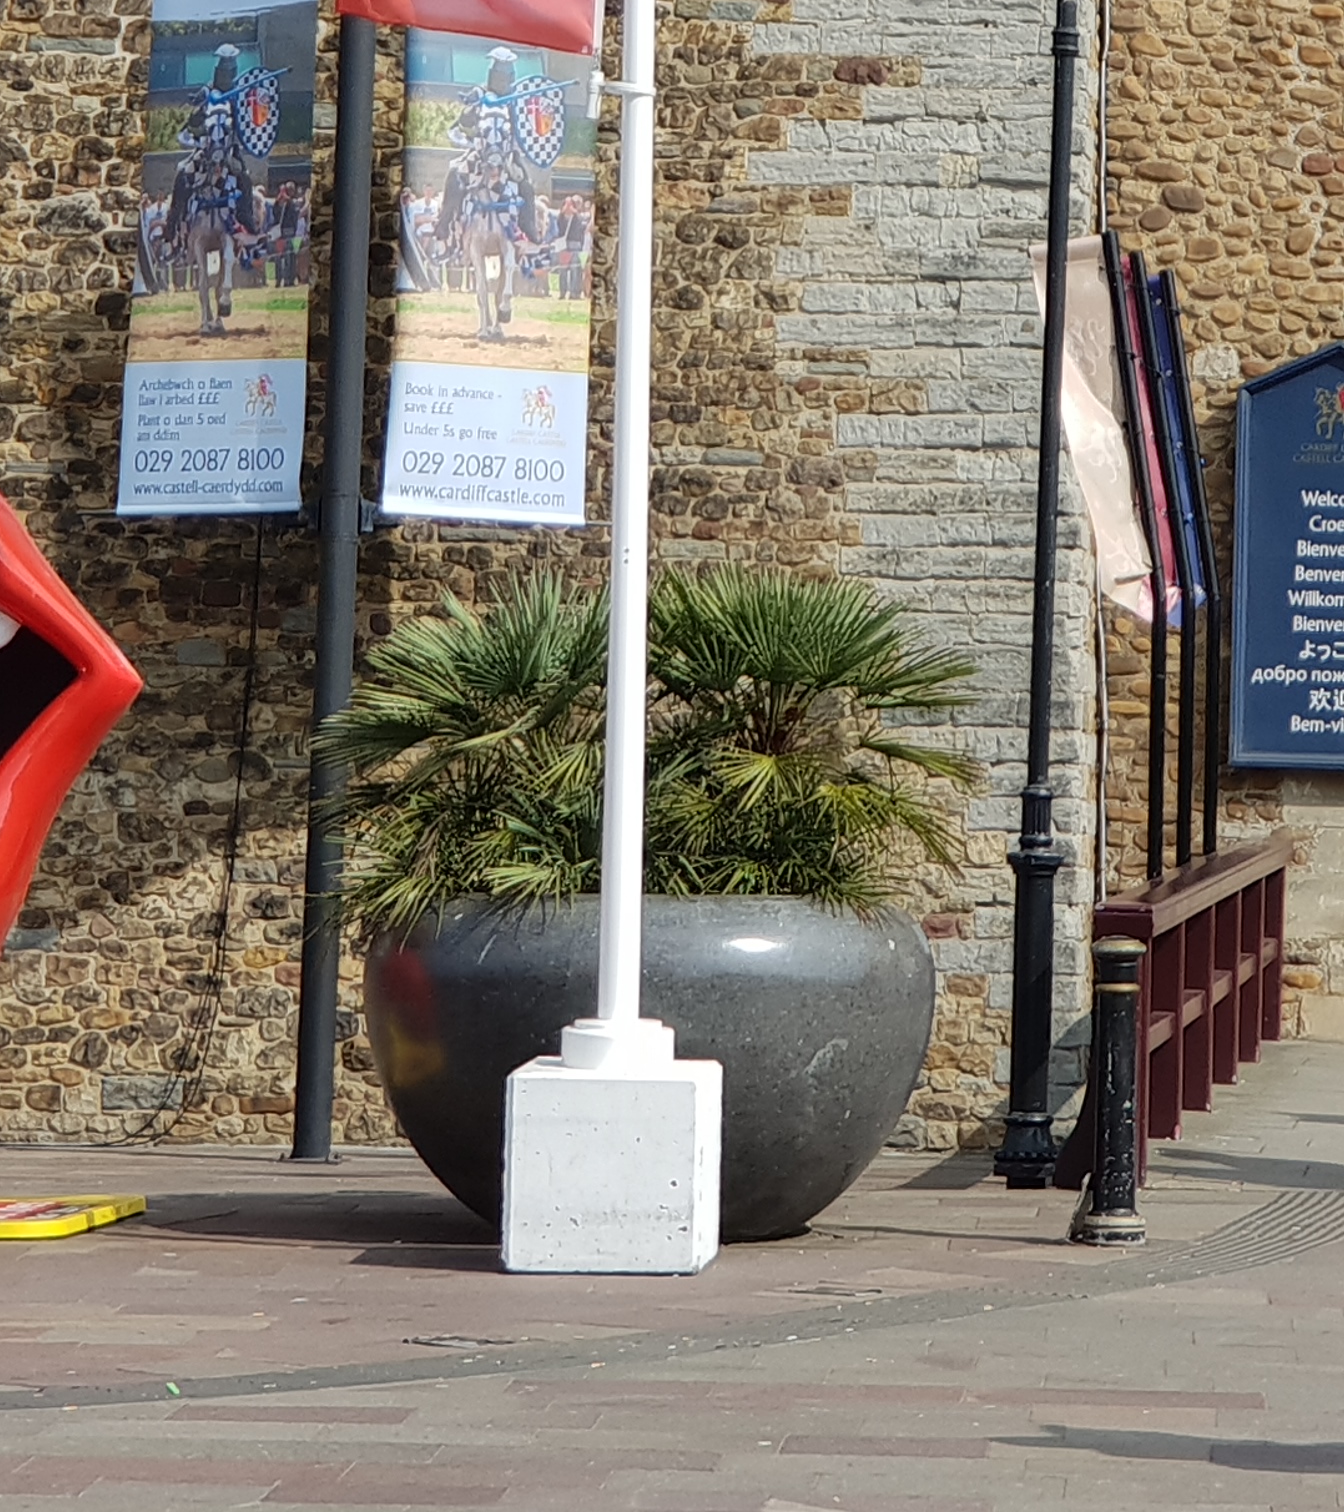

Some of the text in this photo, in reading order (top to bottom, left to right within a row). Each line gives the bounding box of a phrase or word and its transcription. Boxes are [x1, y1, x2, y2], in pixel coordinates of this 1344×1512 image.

[198, 392, 221, 405] £££
[404, 382, 434, 395] Book
[438, 385, 448, 397] in
[452, 386, 494, 399] advance
[404, 401, 454, 415] save £££
[163, 416, 171, 426] o
[197, 413, 204, 425] 5
[403, 422, 439, 436] Under
[443, 424, 455, 437] 5s
[459, 428, 473, 440] go
[477, 426, 498, 440] free
[134, 447, 285, 473] 029 2087 8100
[403, 450, 565, 482] 029 2087 8100
[133, 478, 284, 496] www.castell-caerdydd.com
[399, 483, 565, 507] www.cardiffcastle.com
[1251, 664, 1307, 685] добро
